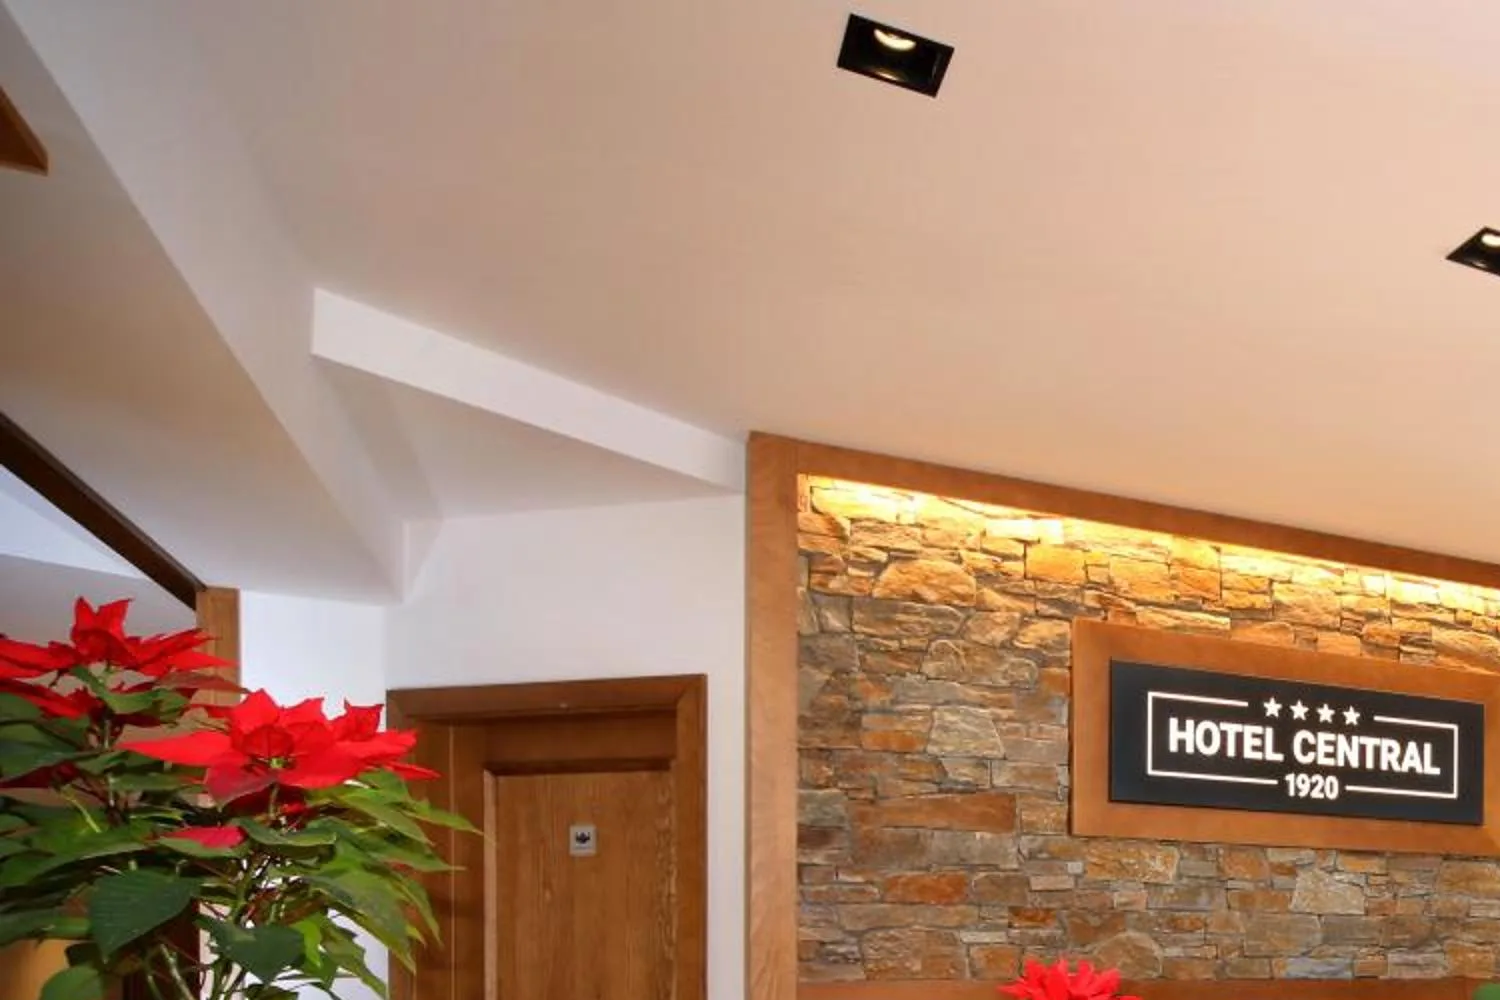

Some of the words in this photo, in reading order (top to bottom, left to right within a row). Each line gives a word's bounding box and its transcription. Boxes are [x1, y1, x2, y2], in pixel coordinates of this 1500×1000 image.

[1168, 717, 1285, 763] HOTEL
[1292, 729, 1441, 776] CENTRAL
[1284, 772, 1340, 800] 1920
